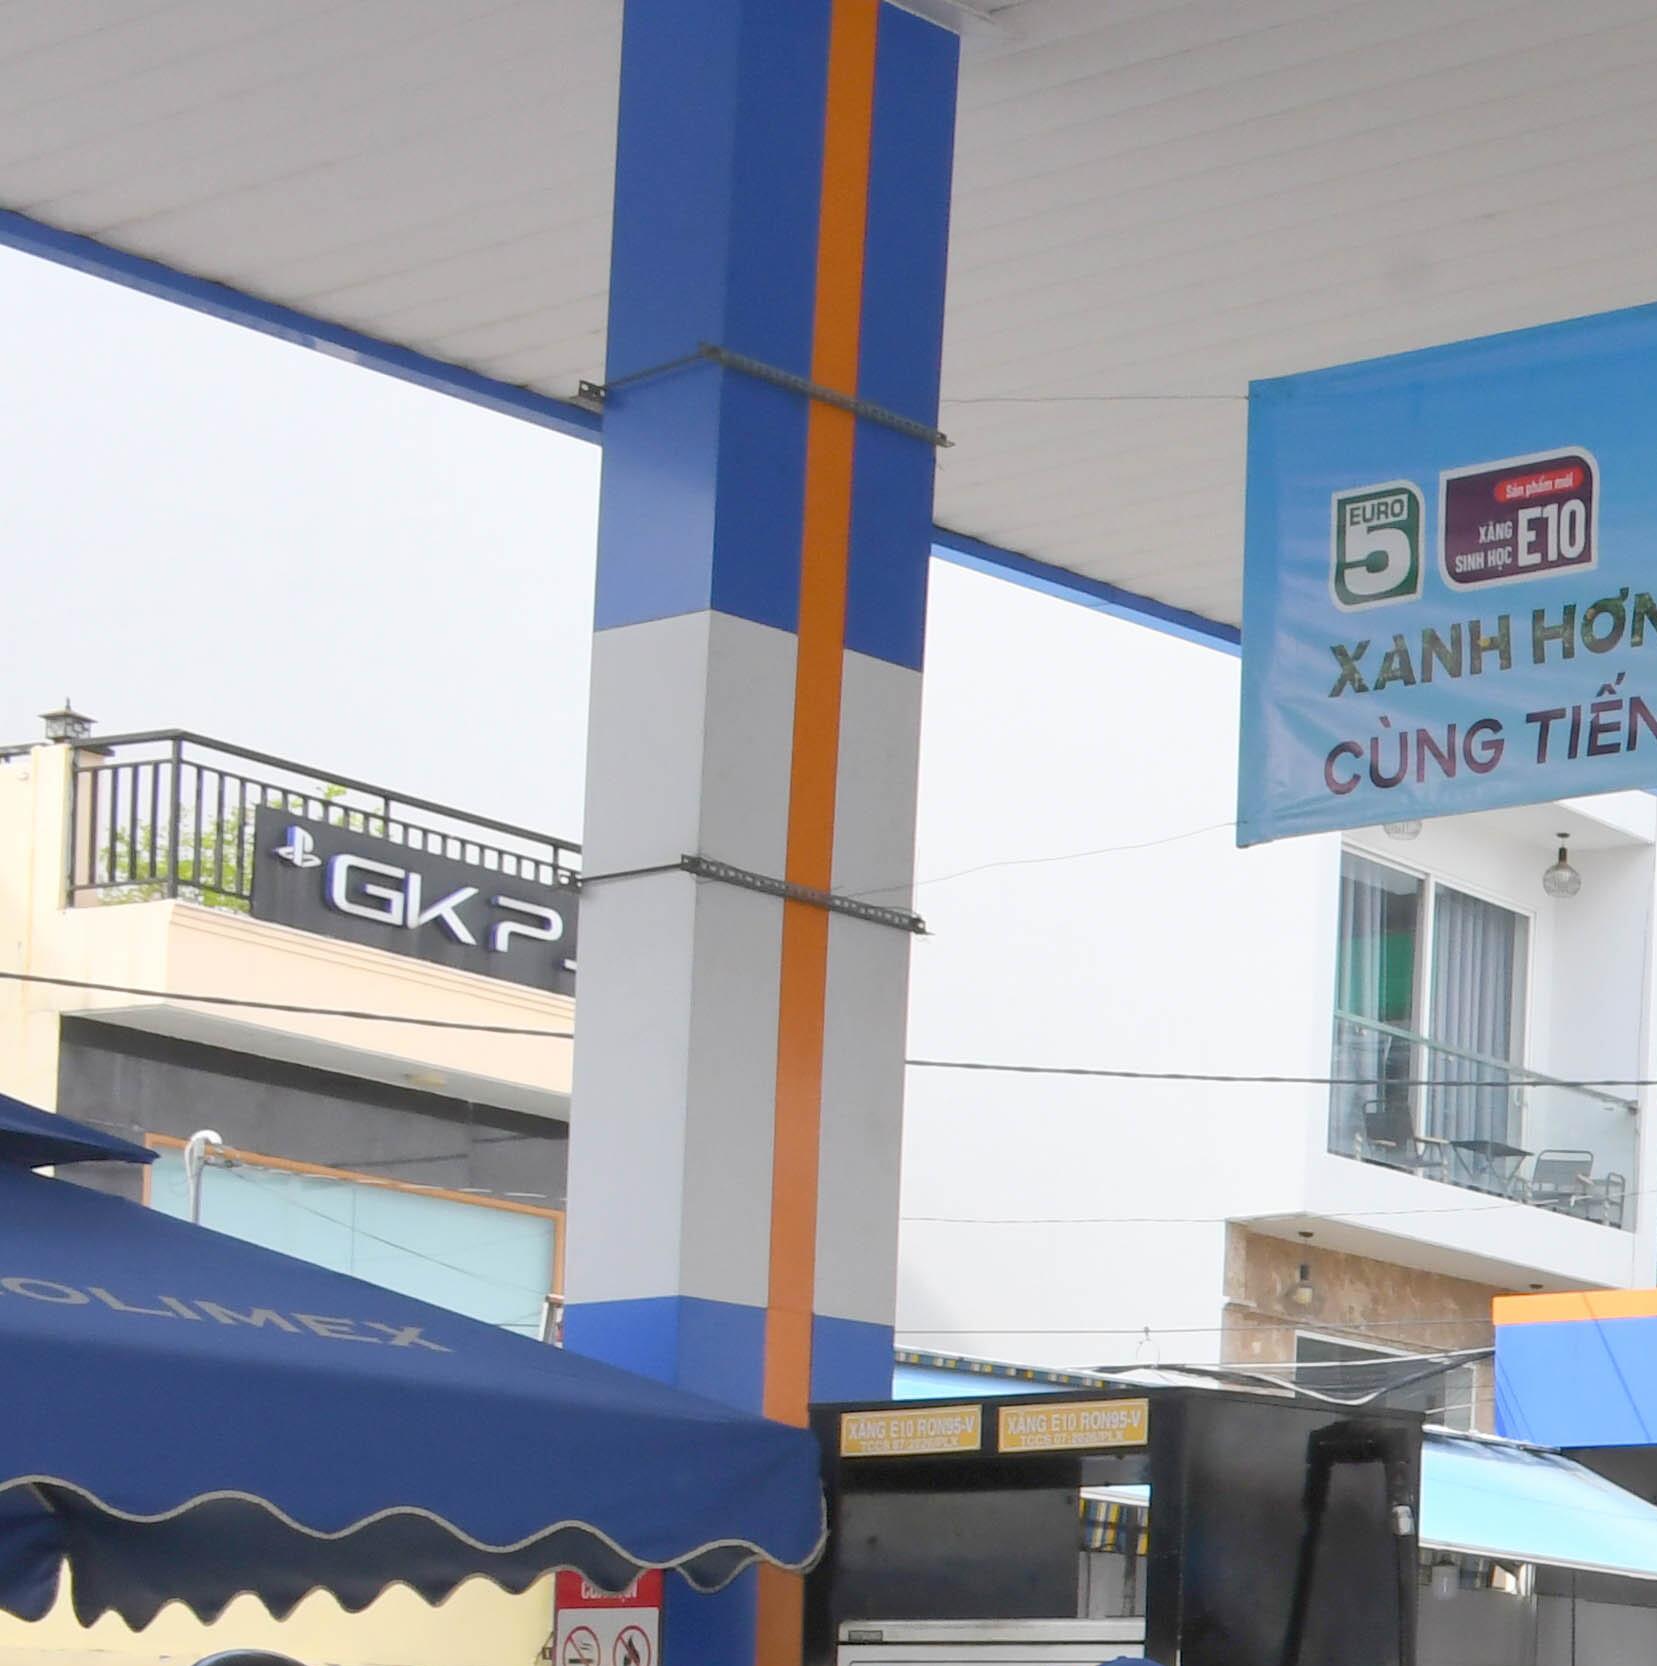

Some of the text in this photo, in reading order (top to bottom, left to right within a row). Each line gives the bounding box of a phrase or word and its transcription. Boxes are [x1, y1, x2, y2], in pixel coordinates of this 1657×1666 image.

[1350, 499, 1405, 526] EURO
[1517, 499, 1586, 568] E10
[1344, 524, 1411, 596] 5
[1455, 546, 1513, 574] SINH HỌC
[1327, 616, 1512, 697] XANH
[1323, 714, 1505, 796] CÙNG
[0, 1276, 454, 1353] OLIMEX
[890, 1419, 912, 1437] E10
[1052, 1415, 1076, 1432] E10
[1081, 1411, 1142, 1430] RON95-V
